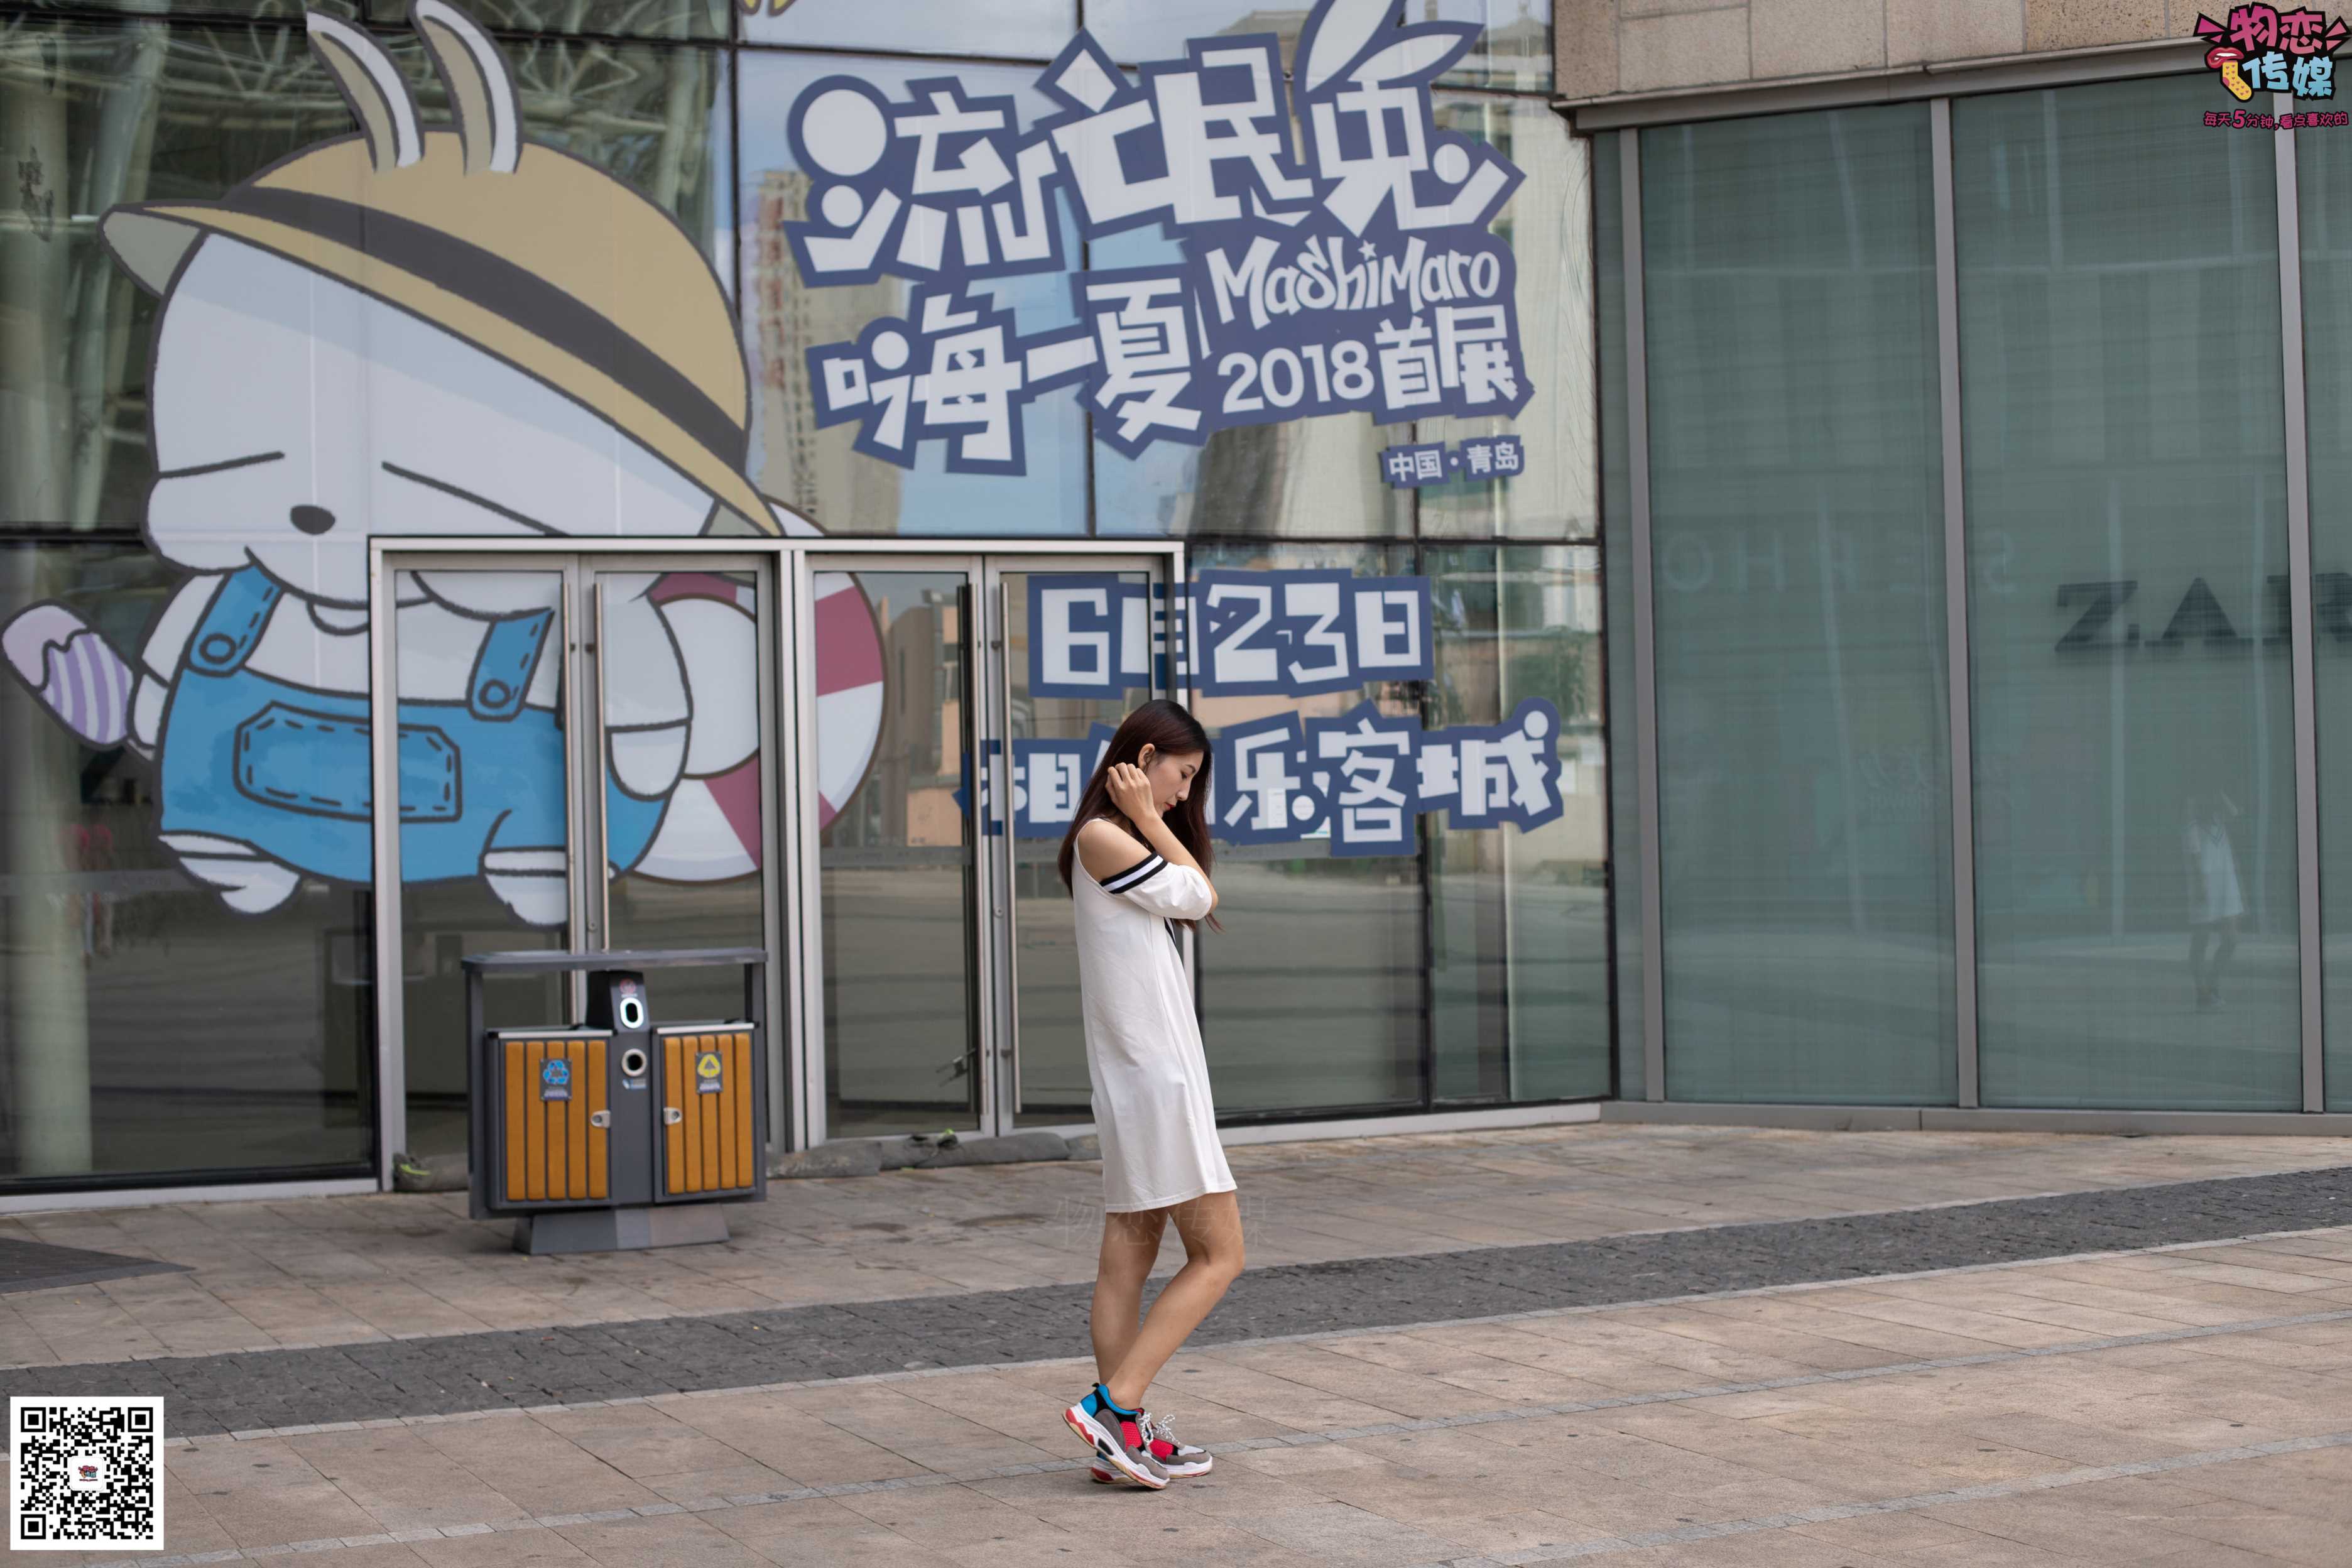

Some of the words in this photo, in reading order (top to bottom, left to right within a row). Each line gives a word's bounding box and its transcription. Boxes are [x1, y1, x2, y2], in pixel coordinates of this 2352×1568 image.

[802, 0, 1508, 273] 流氓兔
[822, 277, 1202, 462] 嗨一夏
